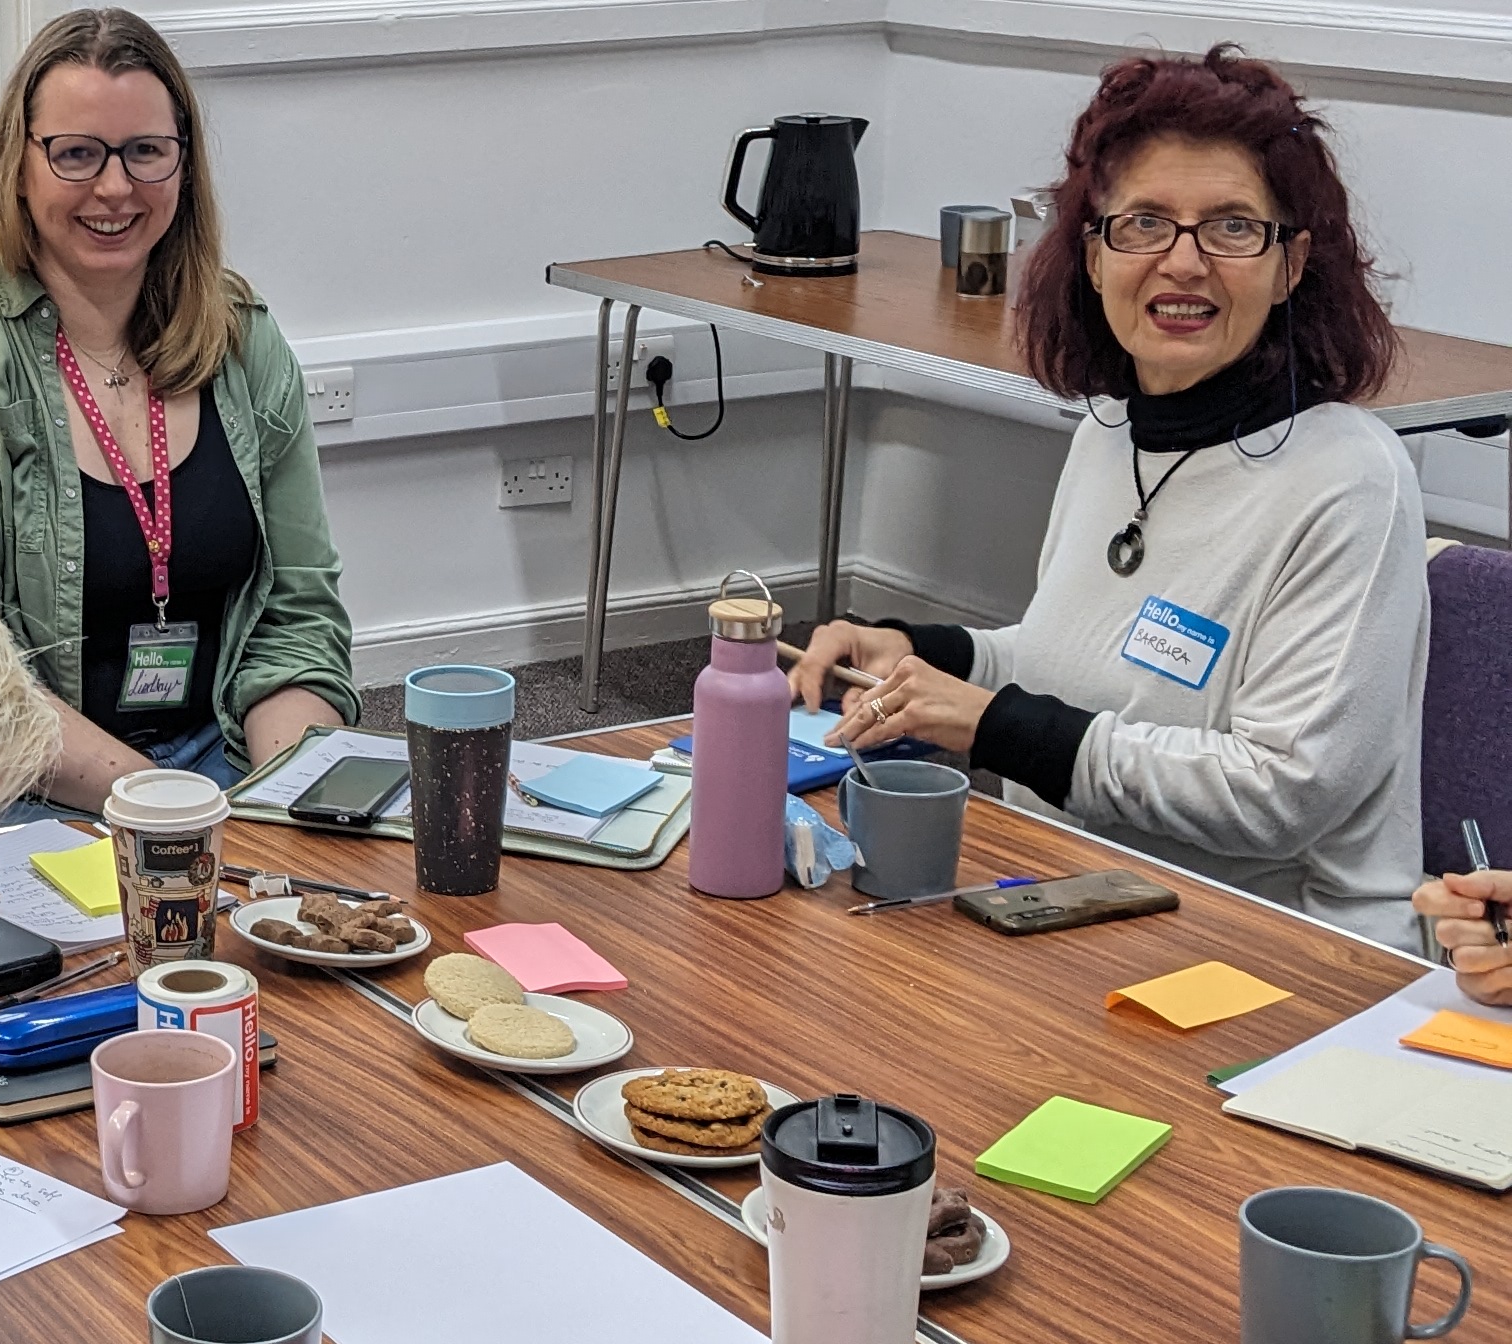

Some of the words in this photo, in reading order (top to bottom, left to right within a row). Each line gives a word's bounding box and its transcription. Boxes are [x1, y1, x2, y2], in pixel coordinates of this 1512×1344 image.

[1143, 600, 1179, 627] Hello
[1187, 627, 1206, 642] name
[135, 651, 163, 666] Hello
[1134, 628, 1191, 665] BARBARA
[244, 1000, 256, 1062] Hello
